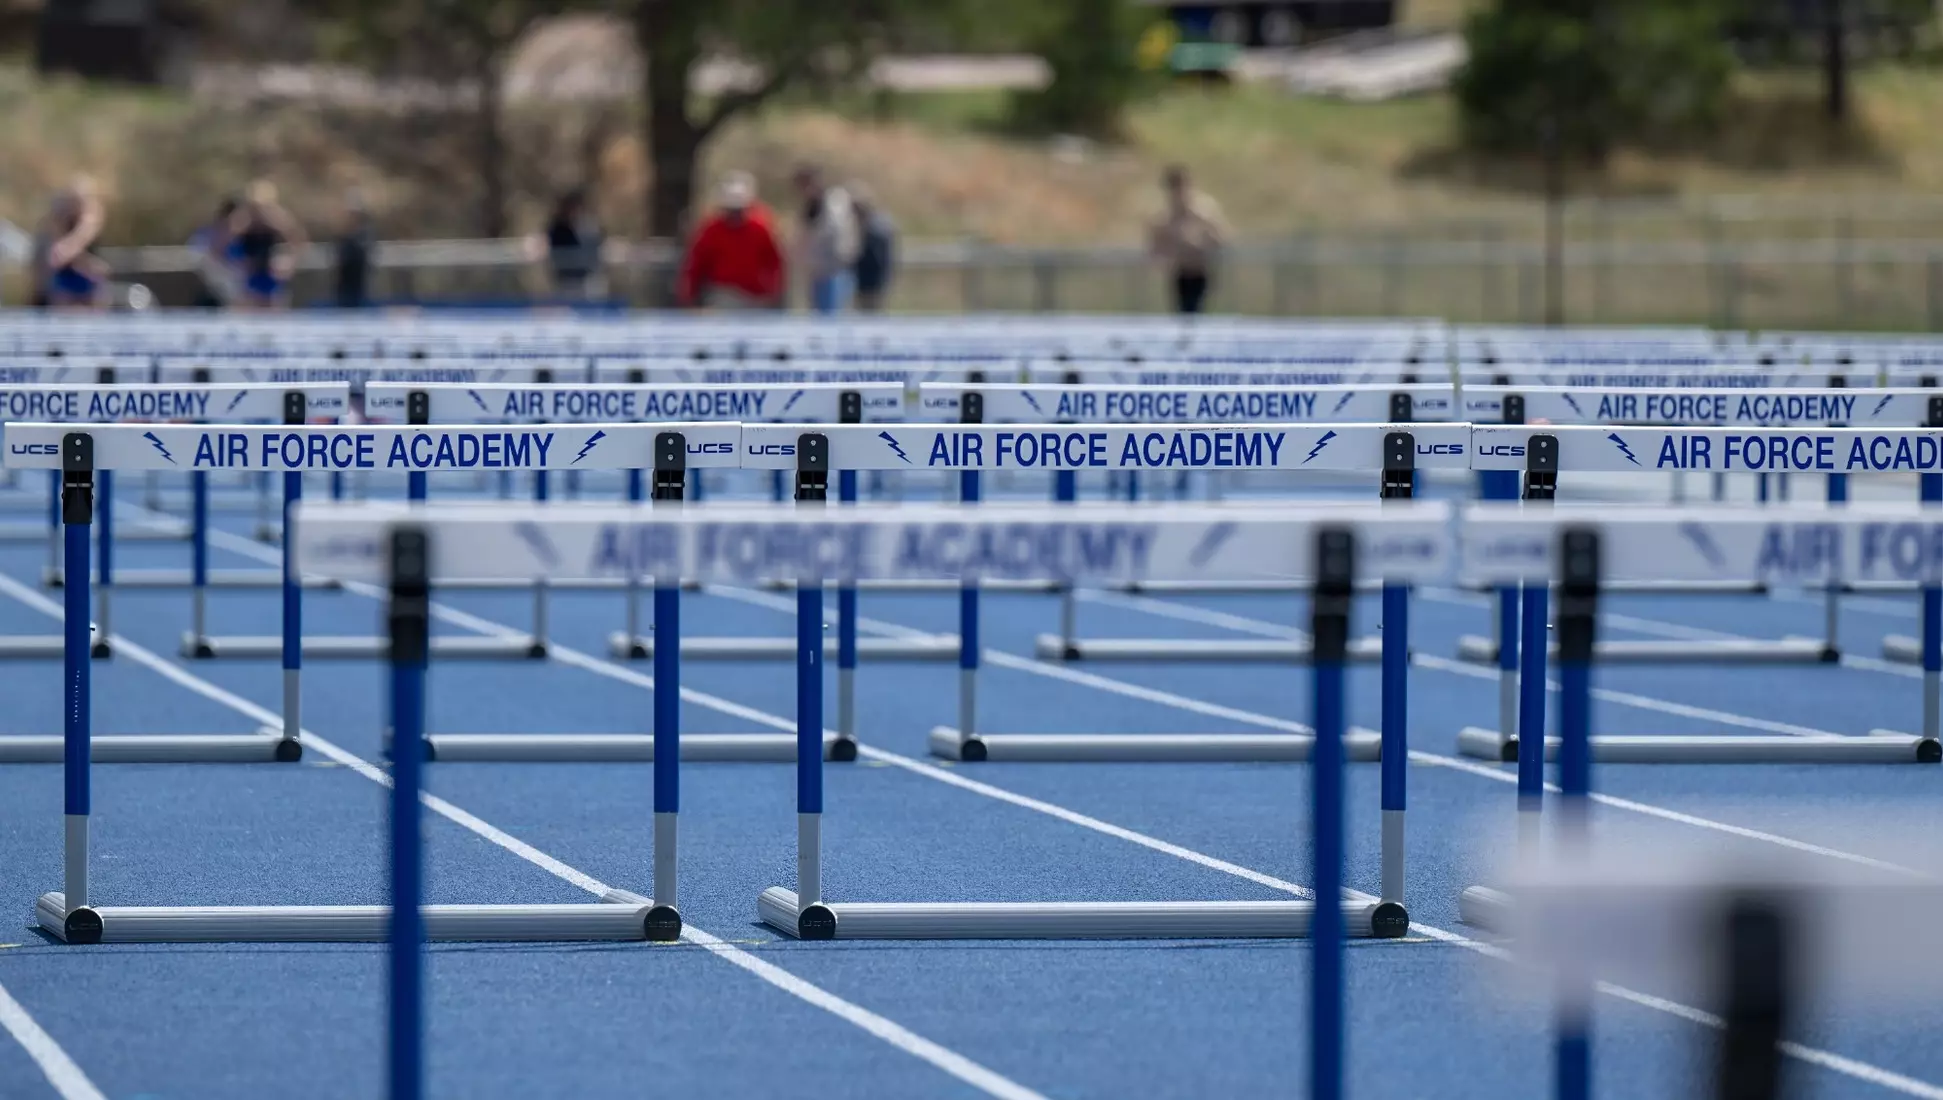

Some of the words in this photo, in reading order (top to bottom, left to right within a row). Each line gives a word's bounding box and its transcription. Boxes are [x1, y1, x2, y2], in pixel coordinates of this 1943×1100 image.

[88, 391, 209, 417] ACADEMY
[504, 391, 544, 417] AIR
[553, 391, 635, 417] FORCE
[645, 391, 767, 417] ACADEMY
[1057, 392, 1096, 418] AIR
[1106, 392, 1187, 418] FORCE
[1196, 392, 1316, 418] ACADEMY
[1597, 395, 1637, 421] AIR
[1646, 395, 1727, 421] FORCE
[1735, 395, 1857, 421] ACADEMY
[11, 444, 59, 455] UCS
[194, 433, 248, 468] AIR
[262, 433, 374, 468] FORCE
[387, 433, 554, 468] ACADEMY
[687, 443, 733, 454] UCS
[749, 444, 796, 456] UCS
[929, 432, 982, 467] AIR
[996, 432, 1107, 467] FORCE
[1119, 432, 1286, 467] ACADEMY
[1417, 444, 1463, 455] UCS
[1479, 445, 1526, 457] UCS
[1657, 435, 1710, 468] AIR
[1724, 435, 1834, 469] FORCE
[1846, 435, 1943, 470] ACAD
[1860, 522, 1943, 579] FO
